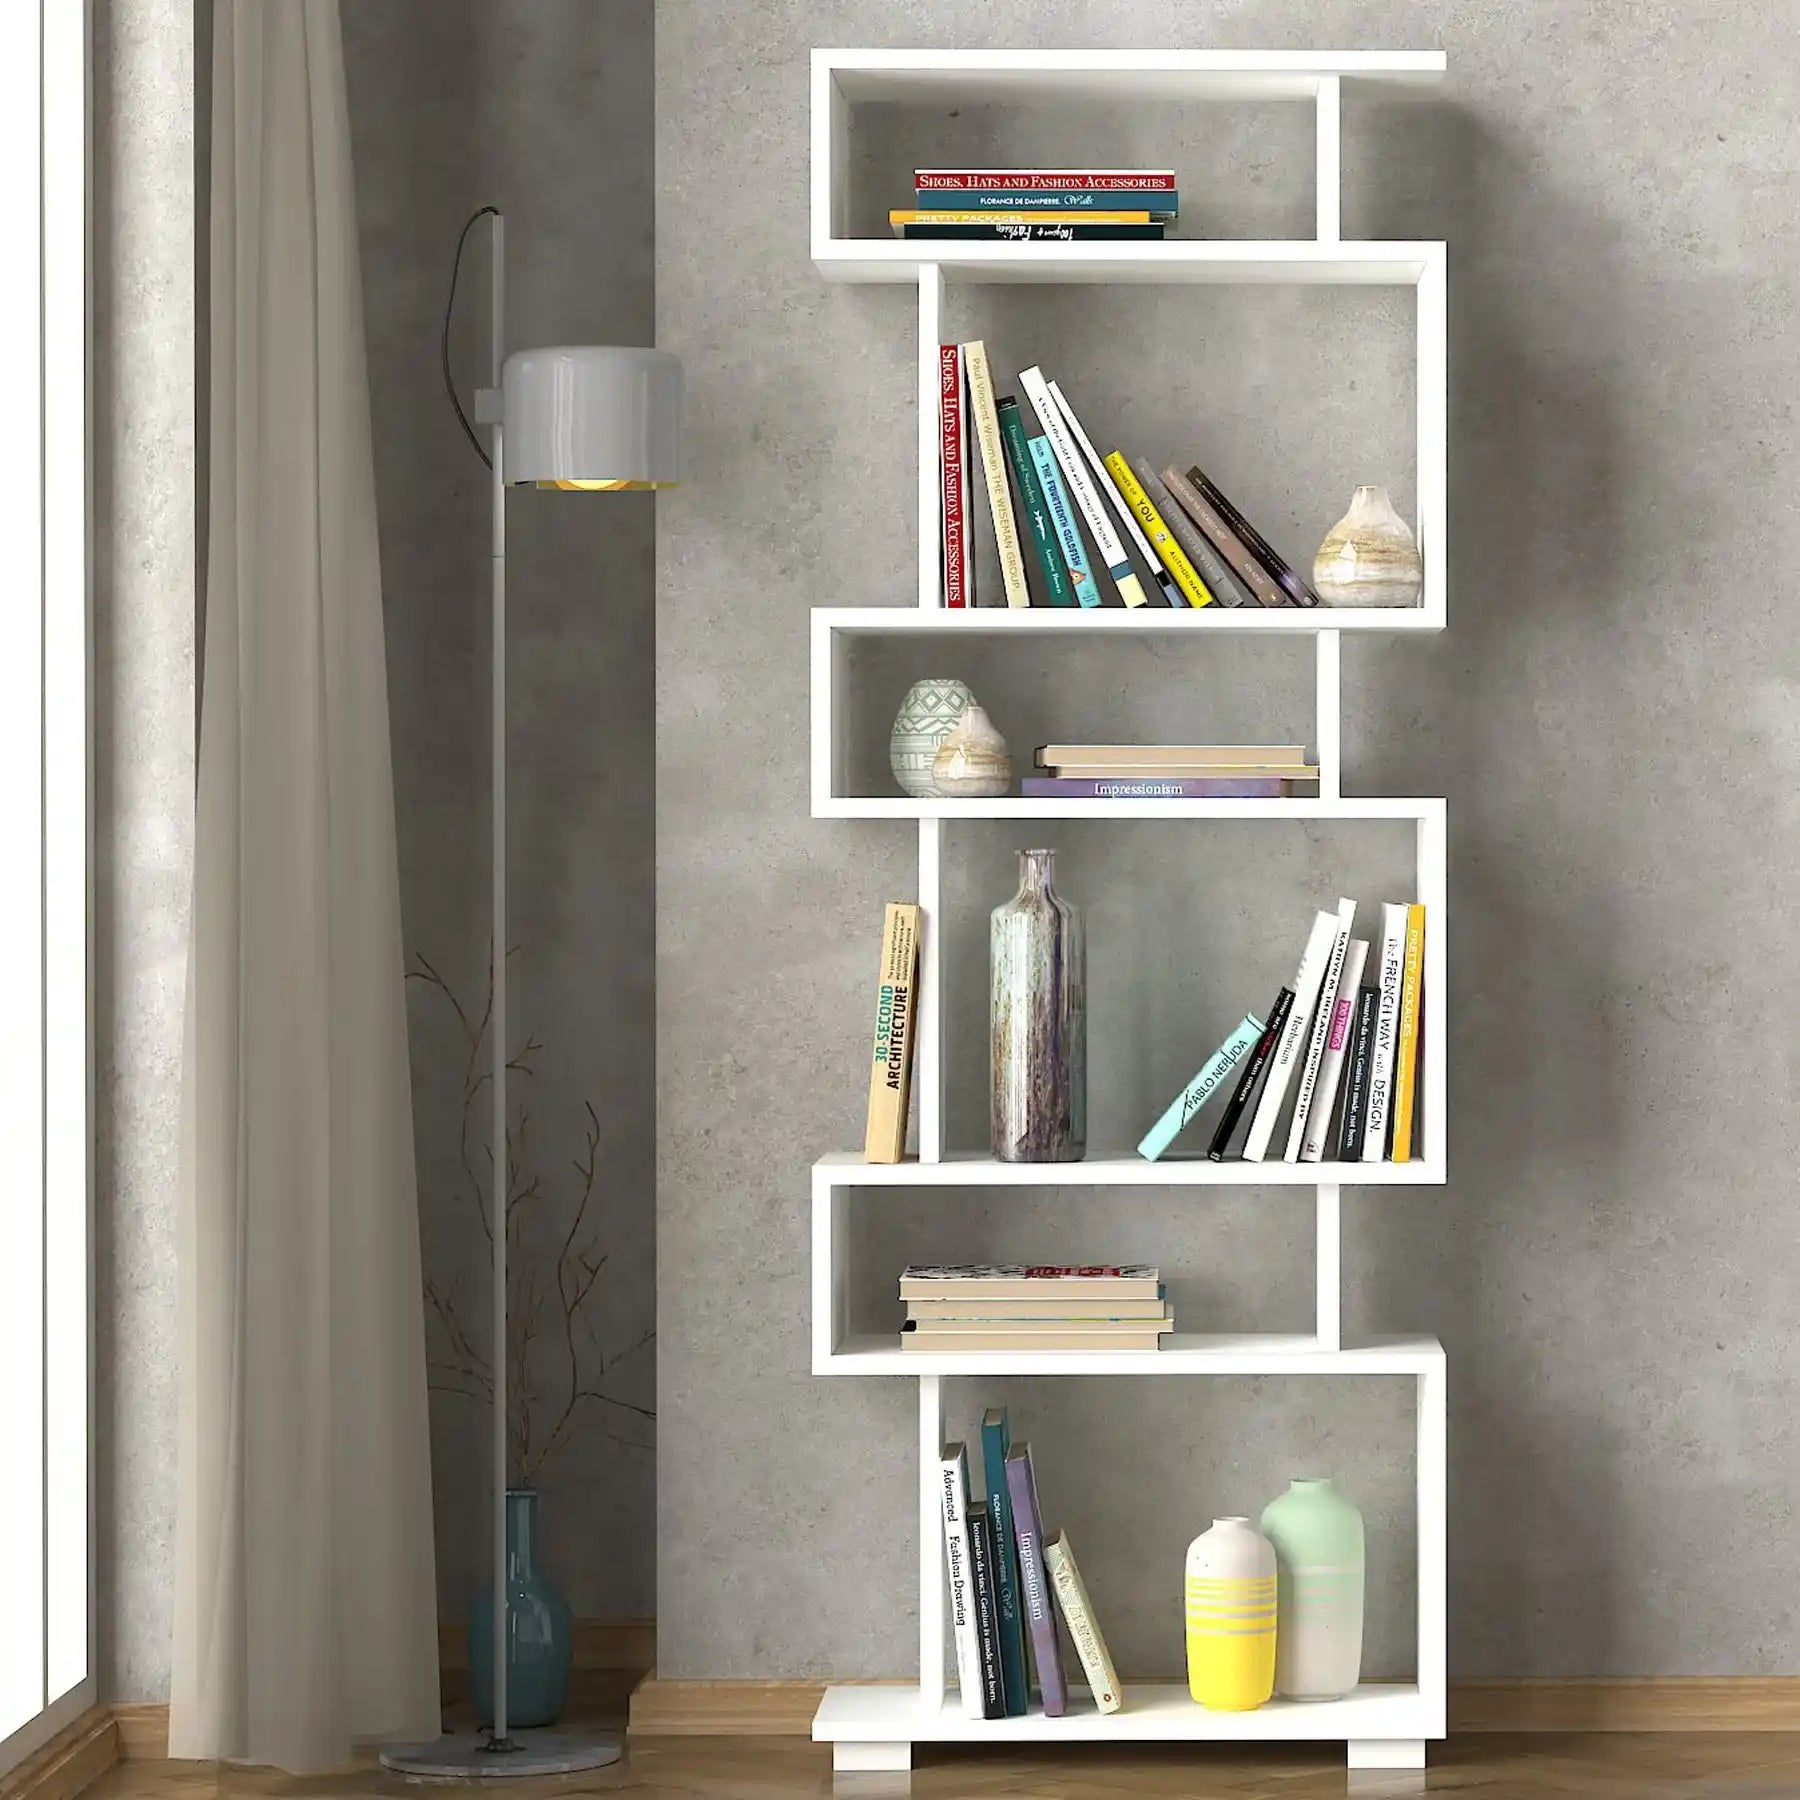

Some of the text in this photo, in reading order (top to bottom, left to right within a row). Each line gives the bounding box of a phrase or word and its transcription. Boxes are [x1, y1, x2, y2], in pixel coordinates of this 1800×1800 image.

[966, 176, 1000, 188] HATS
[1003, 178, 1028, 188] AND
[1031, 175, 1082, 188] FASHION
[1085, 175, 1166, 188] ACCESSORIES
[973, 358, 984, 380] Paul
[944, 398, 957, 432] HATS
[977, 383, 990, 421] Vincent
[945, 435, 956, 460] AND
[984, 424, 998, 471] Wiseman
[946, 463, 959, 515] FASHION
[993, 474, 1004, 494] THE
[997, 498, 1012, 549] WISEMAN
[1041, 463, 1081, 566] THE FOURTEENTH GOLDFISH
[1137, 499, 1154, 522] YOU
[948, 519, 961, 601] ACCESSORIES
[1094, 783, 1183, 798] Impressionism
[1382, 959, 1398, 1014] FRENCH
[1403, 930, 1418, 1036] PRETTY PACKAGES
[876, 986, 893, 1062] 30-SECOND
[887, 987, 907, 1089] ARCHITECTURE
[1280, 1016, 1304, 1065] Herbarium
[1329, 1016, 1348, 1049] THINGS
[1379, 1019, 1391, 1050] WAY
[1185, 1041, 1248, 1110] PABLO NERUDA
[1251, 1057, 1263, 1076] than
[1355, 1058, 1365, 1084] Genius
[1239, 1076, 1254, 1102] others
[1370, 1080, 1386, 1132] DESIGN.
[944, 1470, 958, 1522] Advanced
[950, 1536, 962, 1578] Fashion
[977, 1561, 985, 1572] da
[1021, 1532, 1042, 1620] Impressionism
[954, 1580, 966, 1626] Drawing
[980, 1597, 989, 1628] Genius
[983, 1629, 990, 1637] is
[987, 1665, 995, 1679] not
